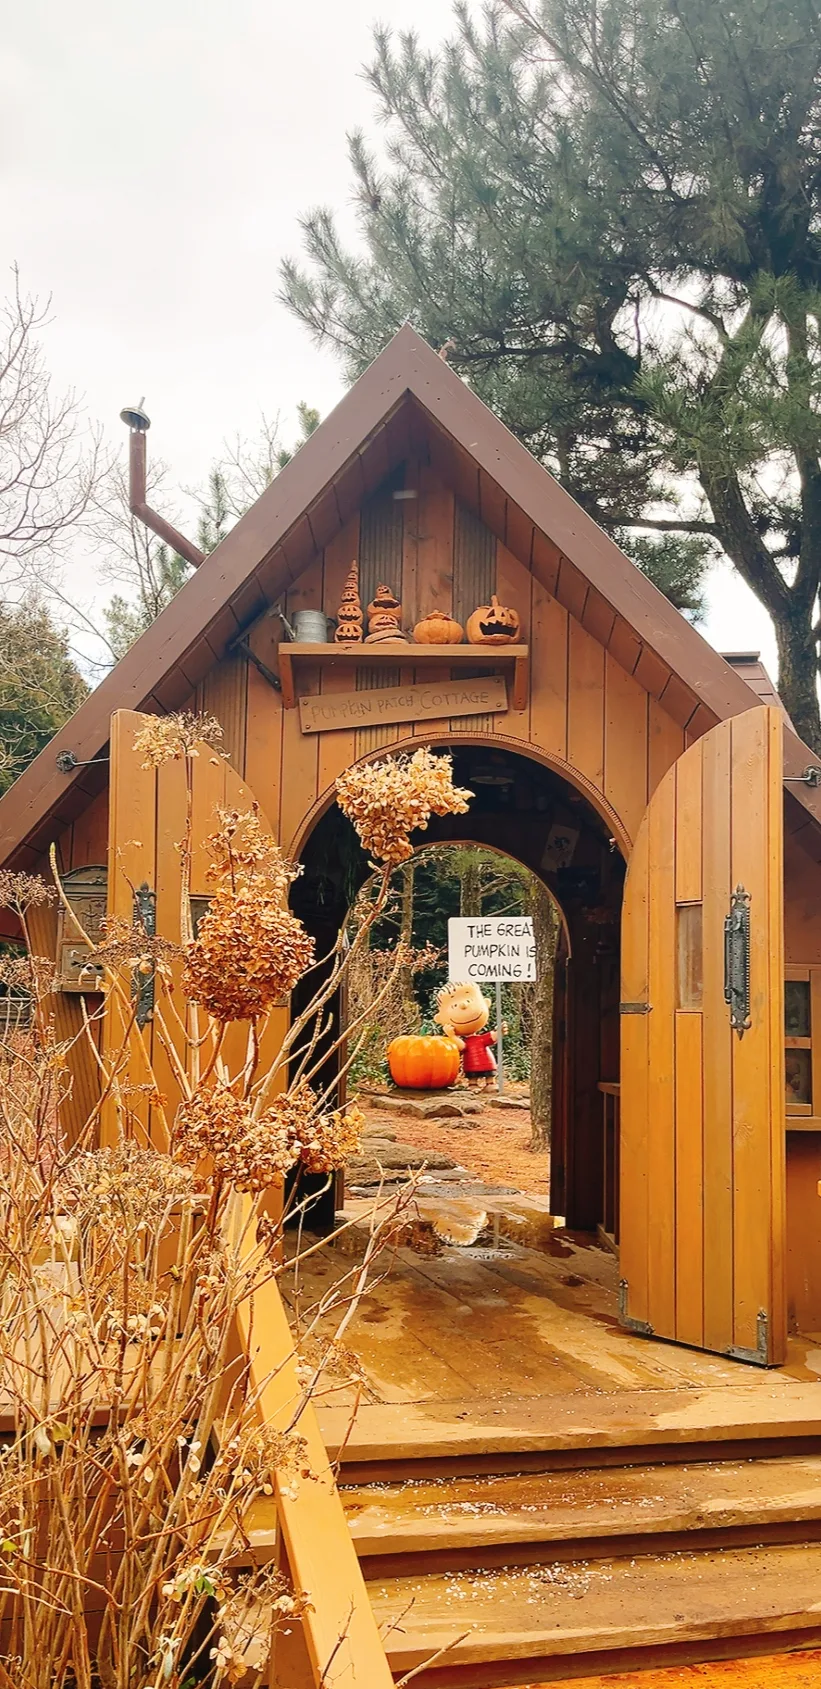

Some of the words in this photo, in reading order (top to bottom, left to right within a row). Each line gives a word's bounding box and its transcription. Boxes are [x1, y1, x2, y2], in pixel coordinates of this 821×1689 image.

[377, 695, 414, 713] PATCH
[420, 690, 489, 709] COTTAGE
[467, 924, 492, 938] THE
[464, 944, 520, 958] PUMPKIN
[526, 945, 538, 958] IS
